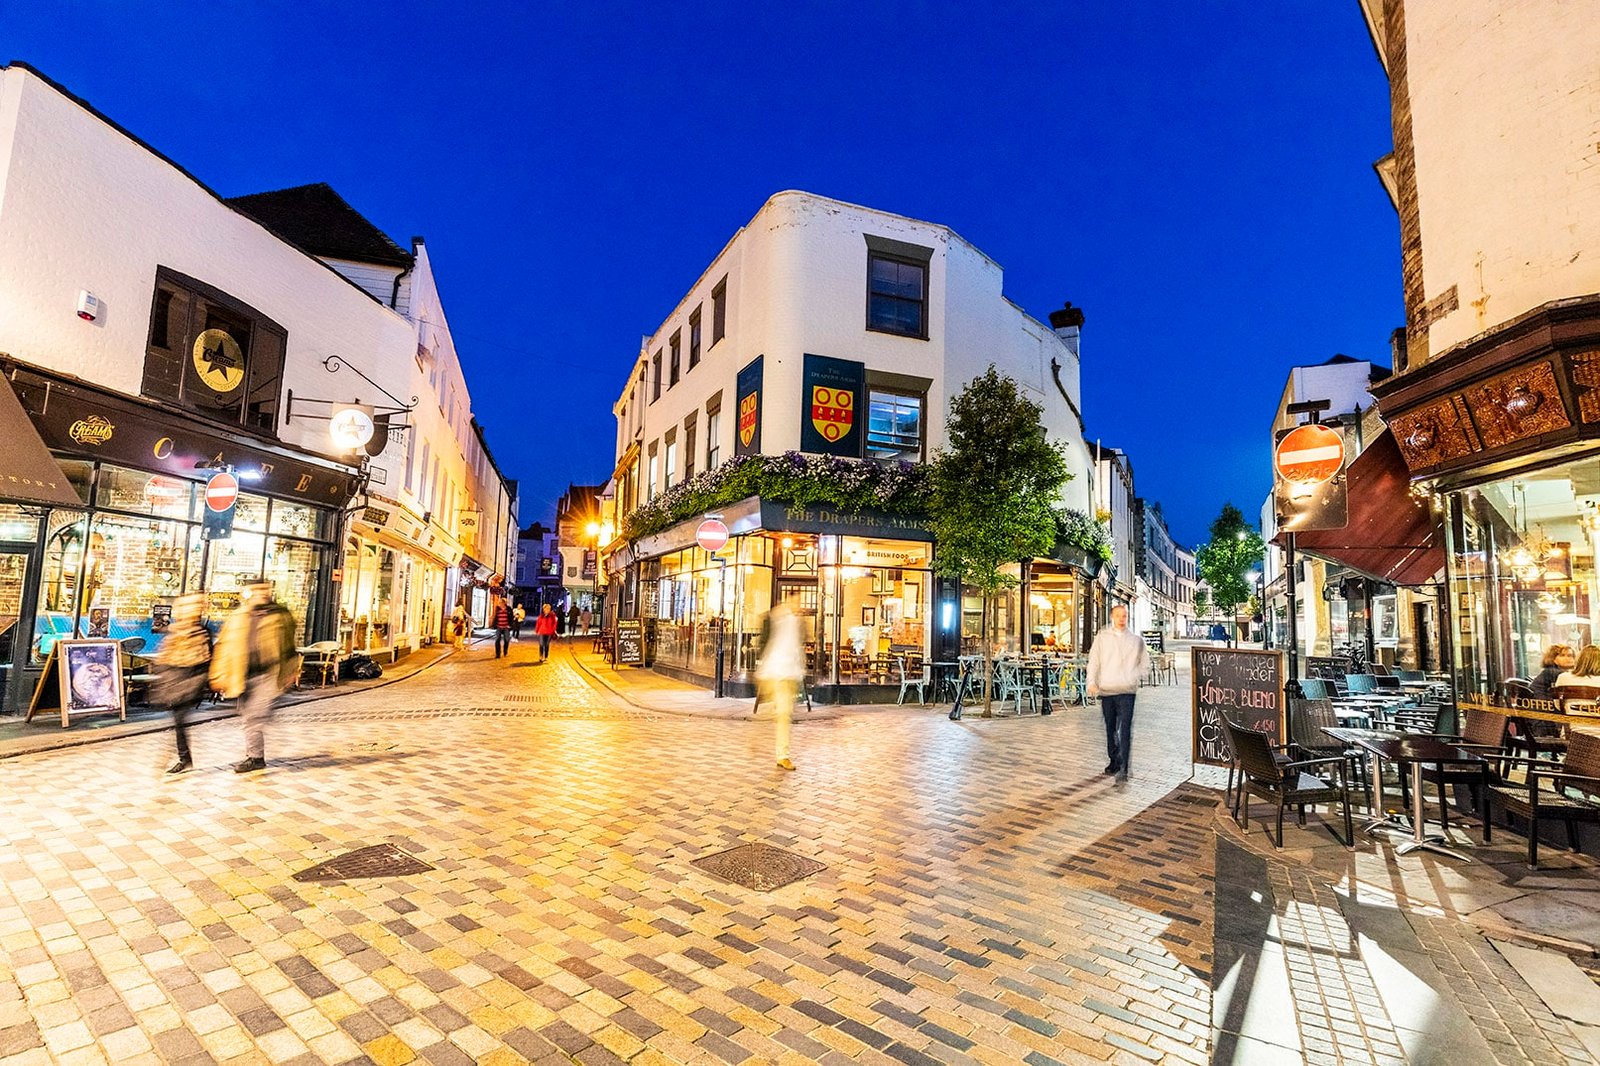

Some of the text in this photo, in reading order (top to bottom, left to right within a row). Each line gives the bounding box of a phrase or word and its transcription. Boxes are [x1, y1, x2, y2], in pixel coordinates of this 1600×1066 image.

[819, 510, 884, 527] DRAPERS
[887, 517, 925, 529] ARMS
[867, 551, 891, 559] BRITISH
[1202, 664, 1213, 677] to
[1198, 679, 1276, 709] KINDER BUENO
[1470, 692, 1494, 705] WINE
[1516, 697, 1555, 711] COFFEE
